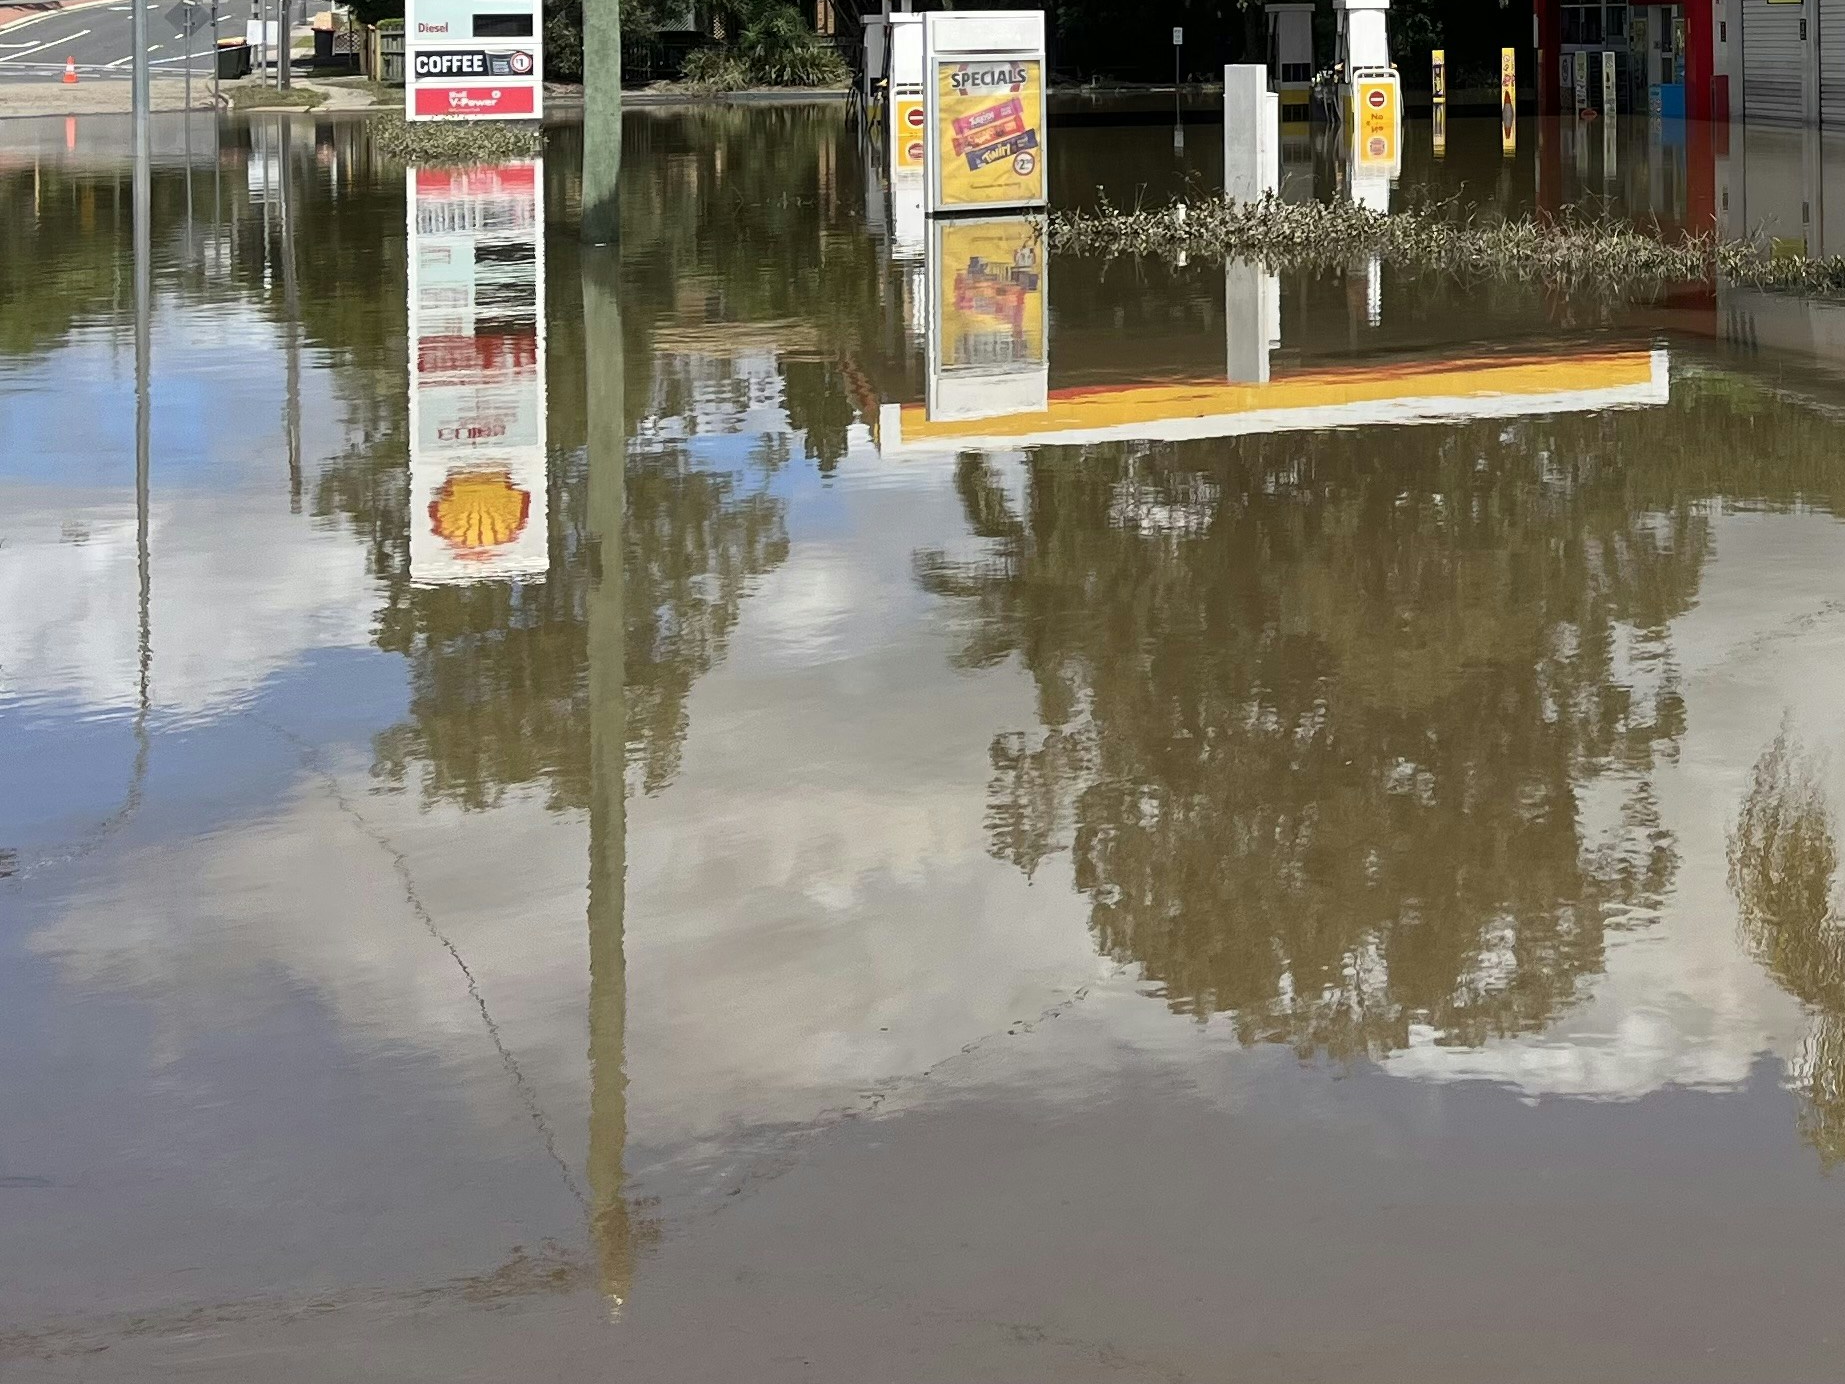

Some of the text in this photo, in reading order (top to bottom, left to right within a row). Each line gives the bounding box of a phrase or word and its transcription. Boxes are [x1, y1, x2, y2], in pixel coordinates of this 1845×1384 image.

[418, 21, 449, 33] Diesel
[416, 54, 484, 74] COFFEE
[951, 68, 1026, 88] SPECIALS
